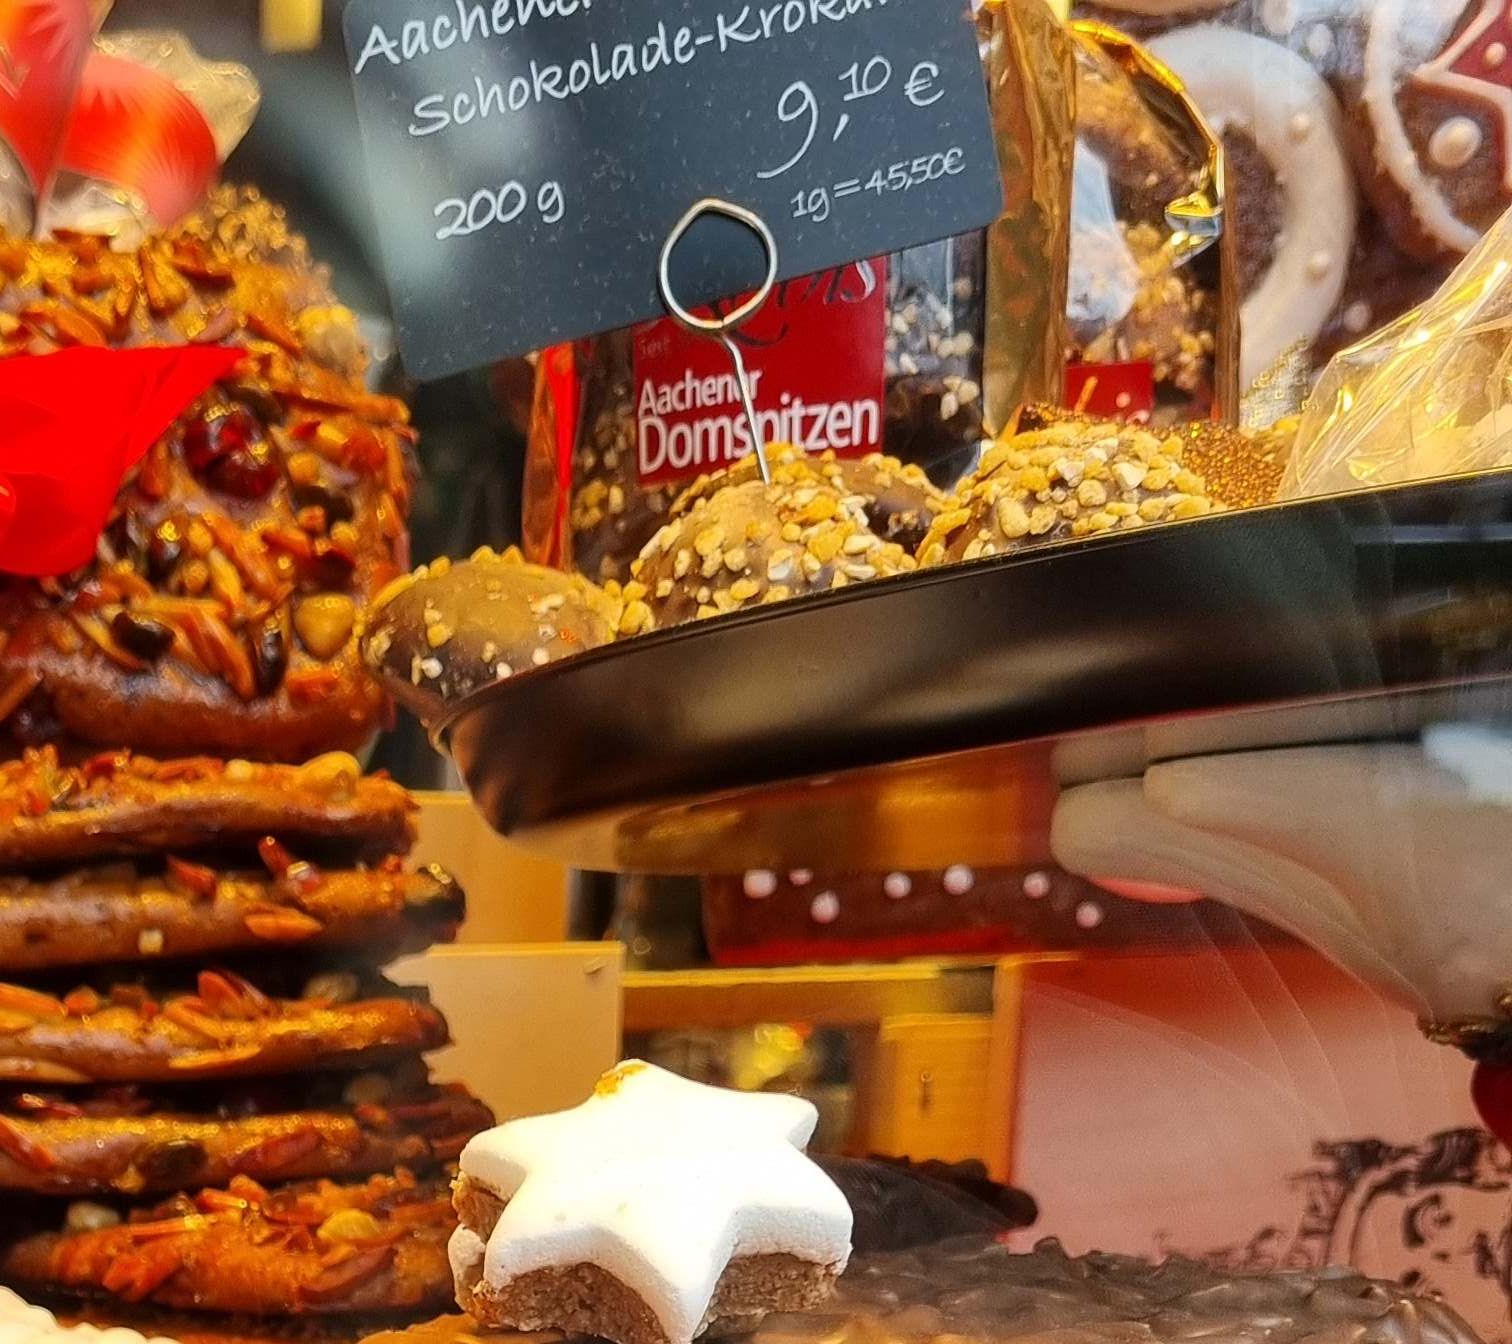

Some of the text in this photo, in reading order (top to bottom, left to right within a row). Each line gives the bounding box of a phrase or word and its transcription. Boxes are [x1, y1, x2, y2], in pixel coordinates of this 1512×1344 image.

[354, 0, 591, 74] Aachene
[408, 0, 890, 136] Schokolade-Krok
[756, 55, 945, 178] 9,10 €
[433, 179, 565, 241] 200 g
[638, 368, 764, 417] Aachener
